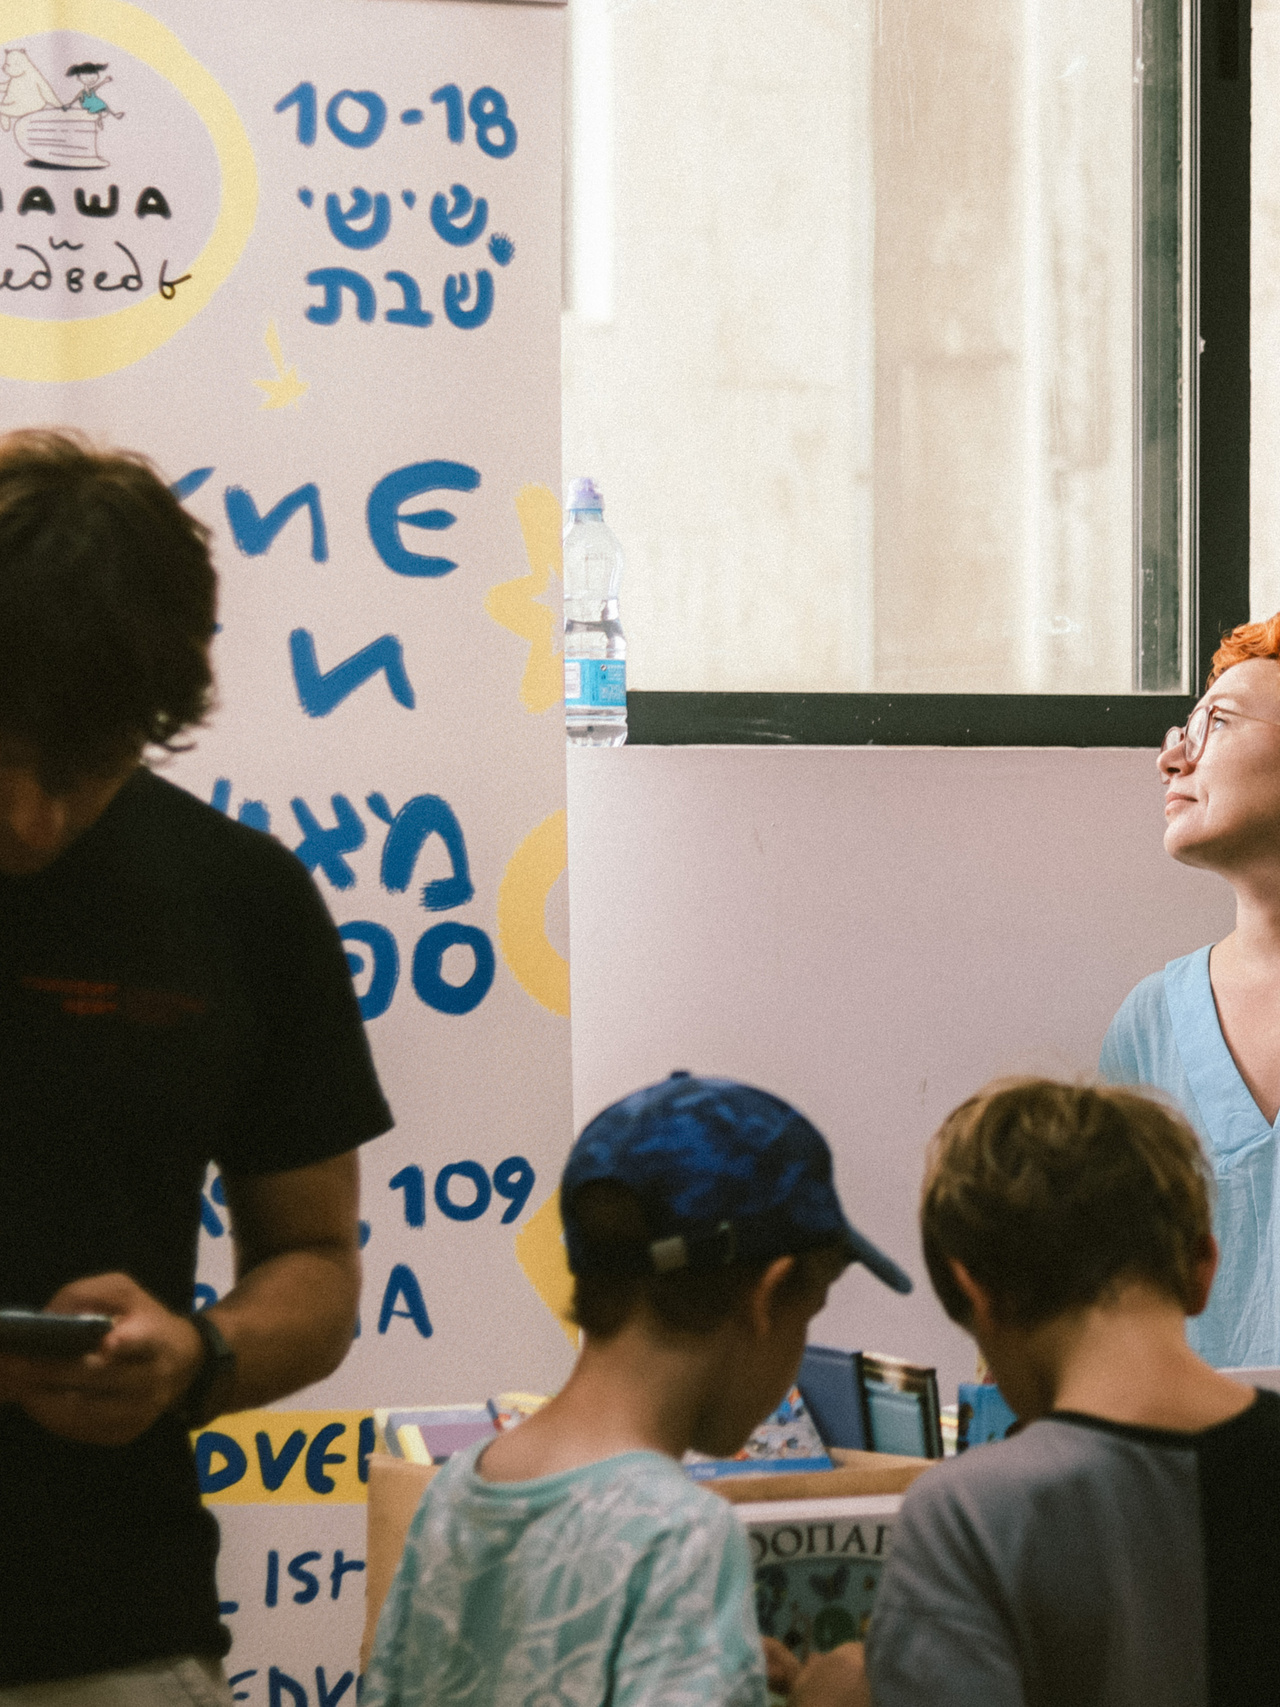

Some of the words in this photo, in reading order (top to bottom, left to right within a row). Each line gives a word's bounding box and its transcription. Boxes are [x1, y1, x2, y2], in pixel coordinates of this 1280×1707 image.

[274, 81, 518, 159] 10-18
[0, 183, 172, 220] АША
[0, 240, 192, 300] едведь
[304, 266, 495, 330] שבת
[168, 459, 482, 578] ИЕ
[388, 1155, 536, 1228] 109
